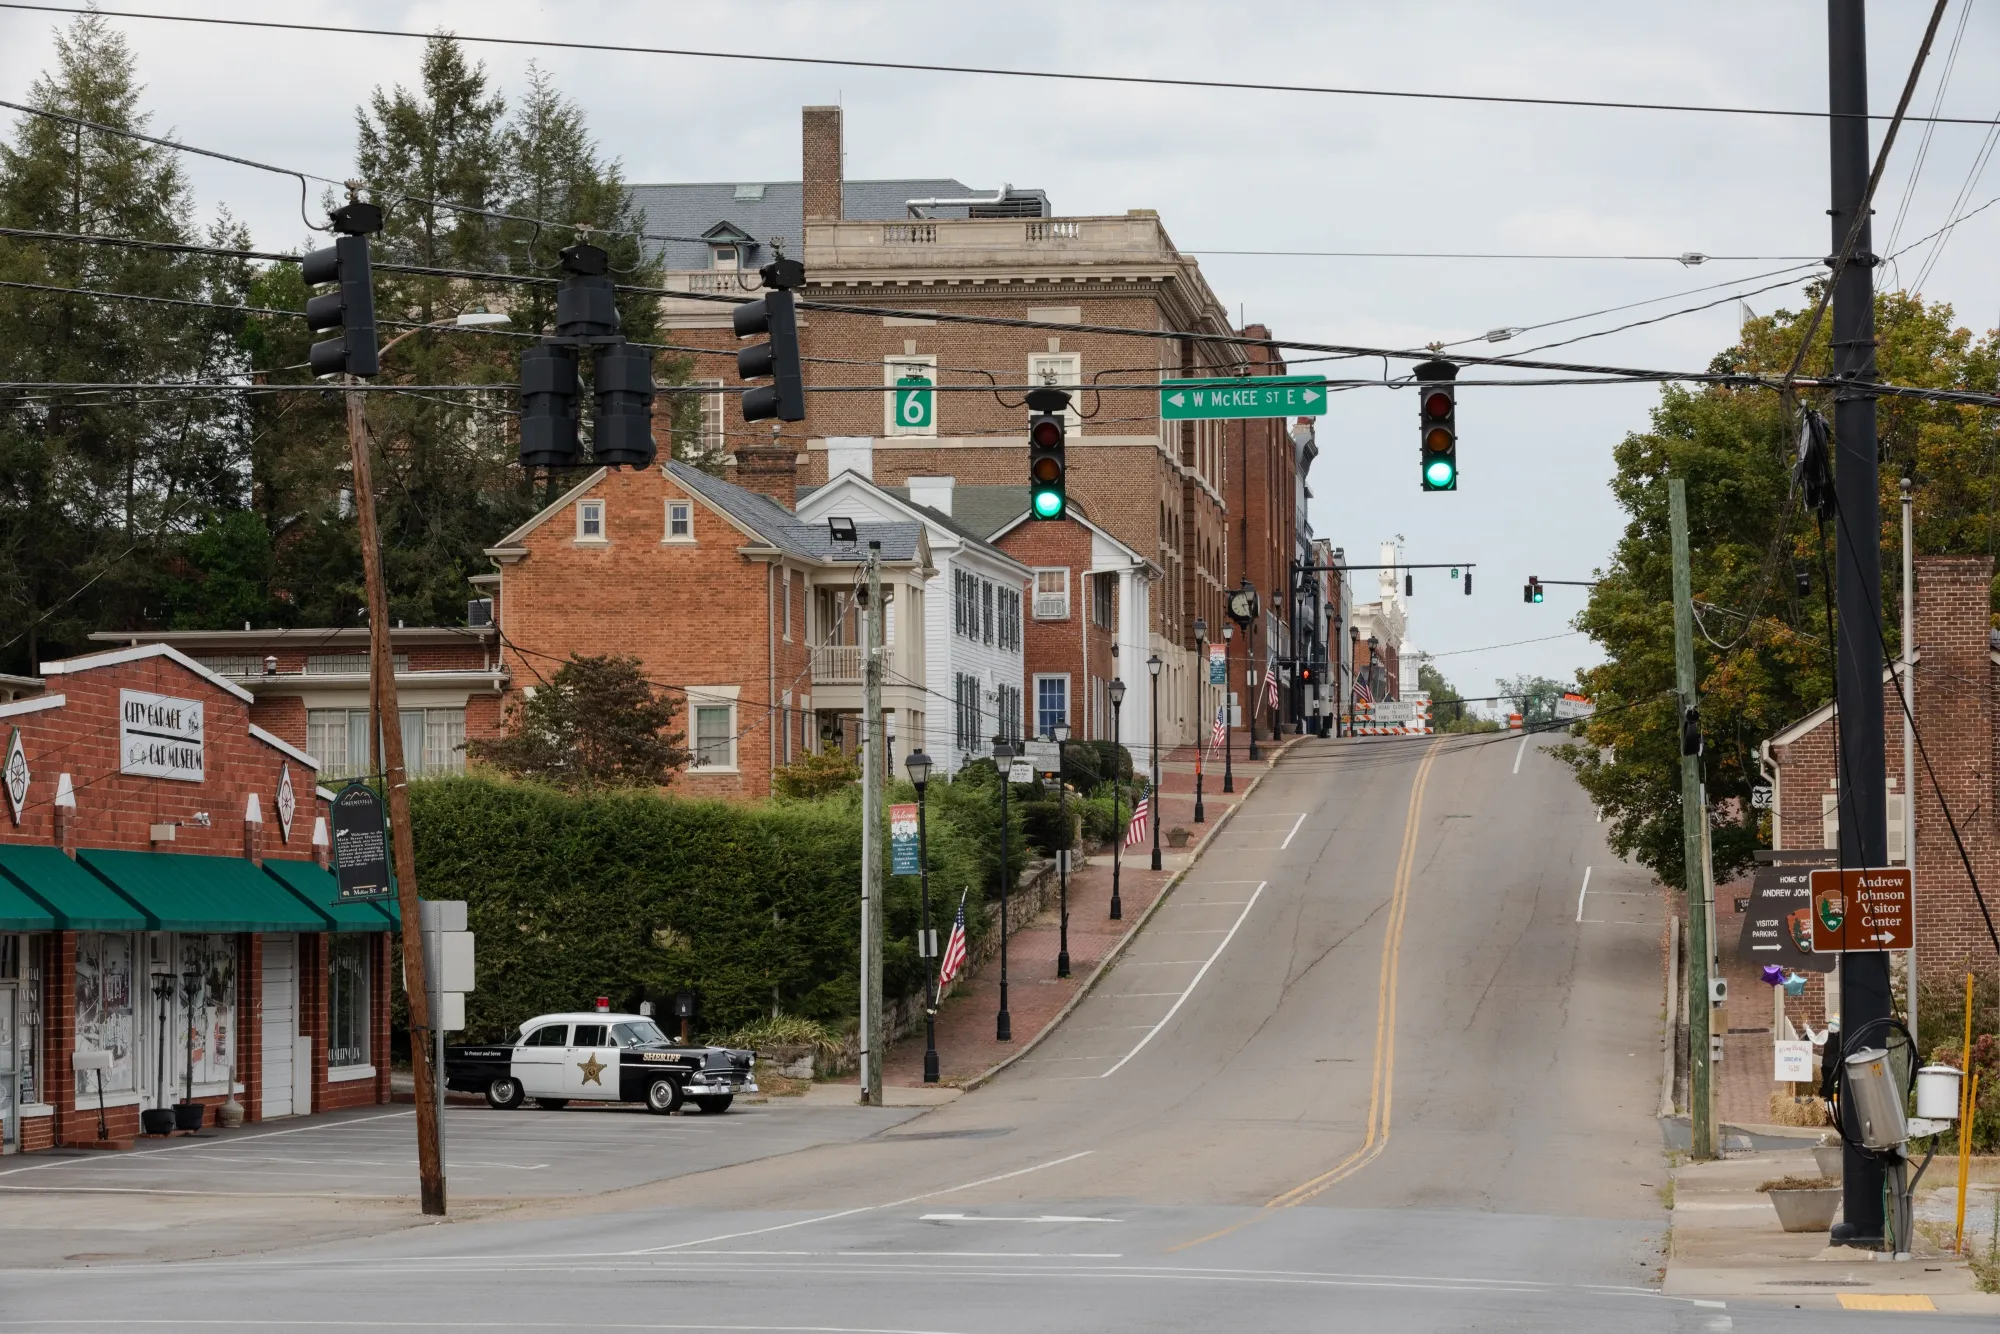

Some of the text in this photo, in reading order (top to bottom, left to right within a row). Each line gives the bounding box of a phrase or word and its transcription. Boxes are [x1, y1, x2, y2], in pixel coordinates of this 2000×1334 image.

[1193, 389, 1295, 407] W McKEE ST E
[903, 389, 924, 424] 6
[125, 700, 182, 730] CITY GARAGE
[149, 743, 203, 770] CAR MUSEUM
[1857, 876, 1904, 888] Andrew
[1762, 888, 1811, 897] ANDREW JOHN
[1855, 889, 1905, 904] Johnson
[1756, 919, 1779, 927] VISITOR
[1752, 930, 1778, 938] PARKING
[643, 1052, 681, 1062] SHERIFF
